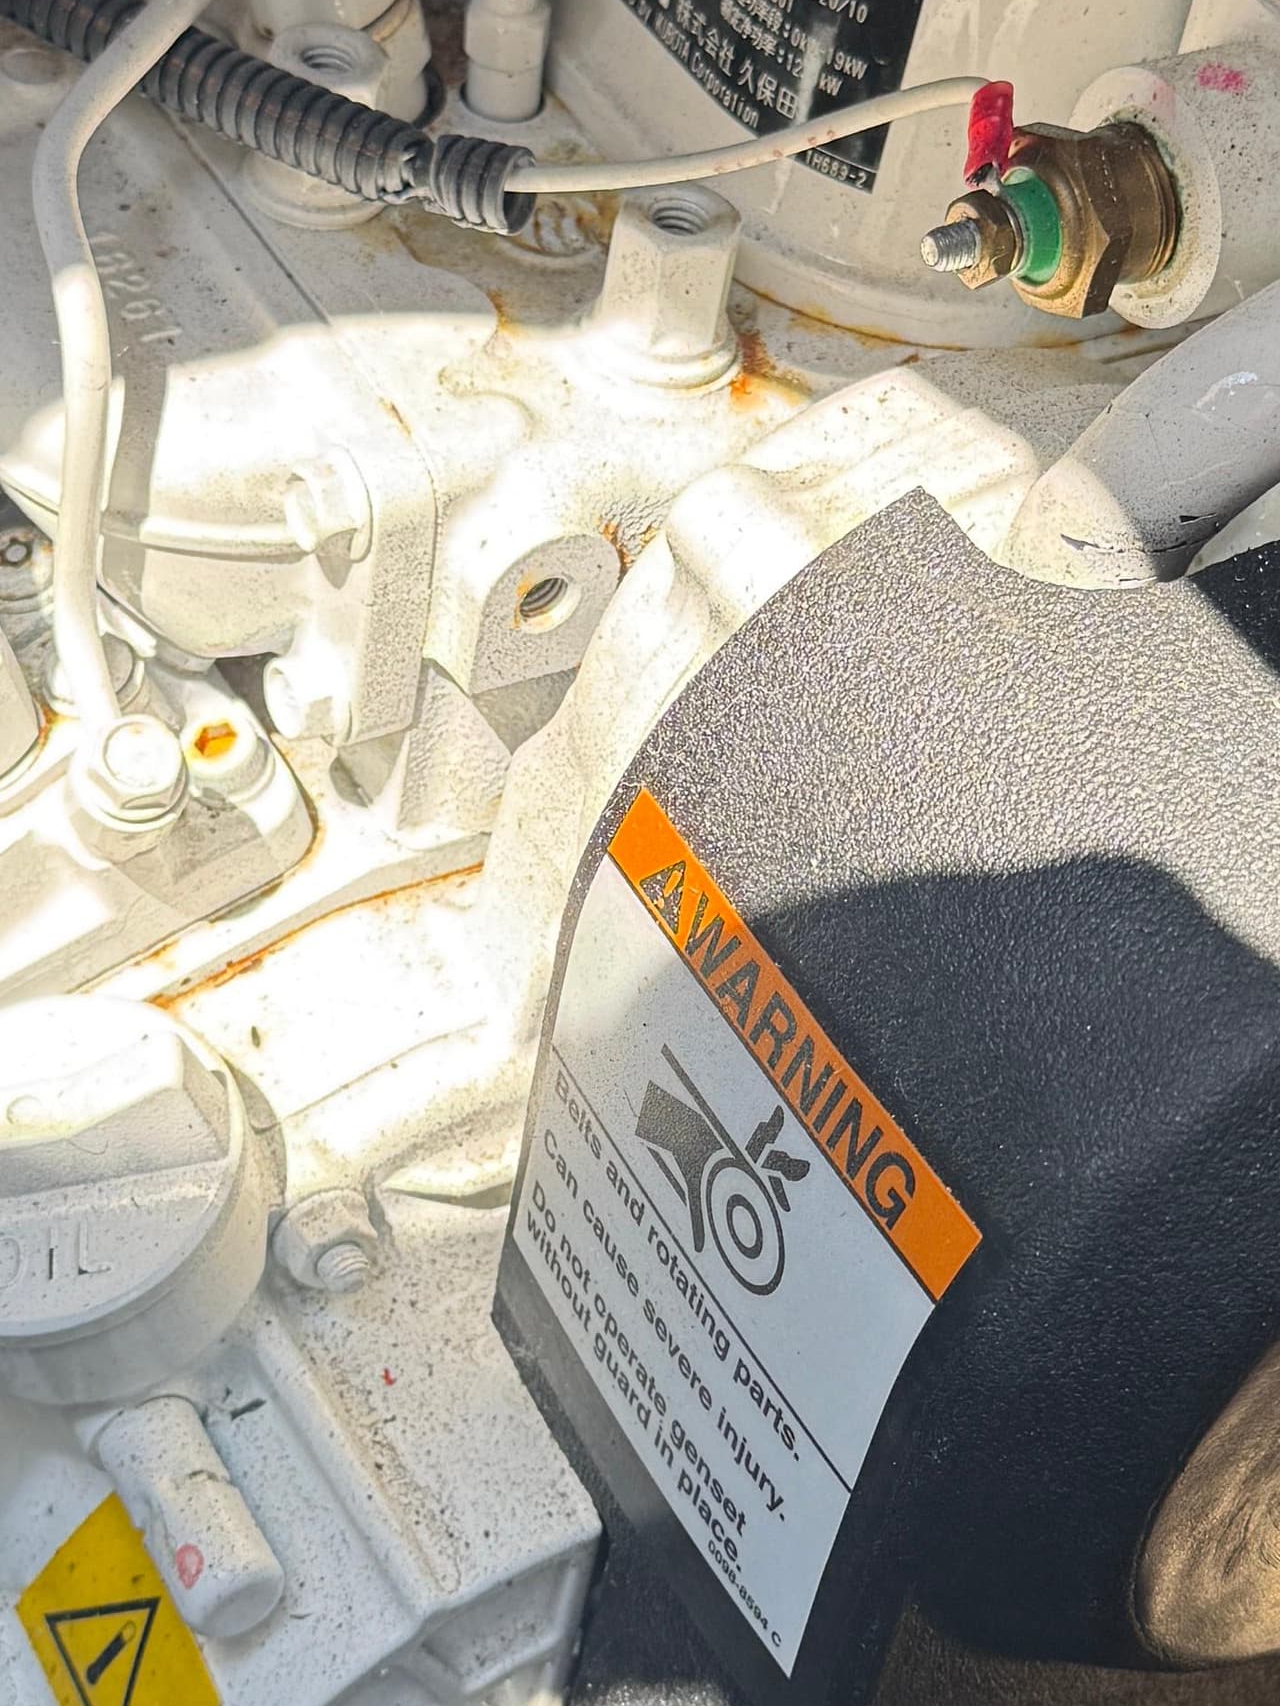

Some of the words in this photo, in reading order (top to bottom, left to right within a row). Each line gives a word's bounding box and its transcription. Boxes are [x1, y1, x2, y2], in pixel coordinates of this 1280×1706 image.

[691, 51, 759, 128] Corporation
[738, 57, 799, 119] 久保田
[682, 891, 916, 1229] WARNING
[526, 1210, 592, 1333] without
[592, 1332, 652, 1431] guard
[654, 1424, 674, 1469] in
[676, 1468, 742, 1574] place.
[531, 1179, 557, 1234] Do
[559, 1233, 591, 1292] not
[592, 1292, 667, 1418] operate
[669, 1419, 747, 1538] genset
[544, 1128, 579, 1200] Can
[582, 1198, 640, 1298] cause
[642, 1297, 713, 1411] severe
[716, 1406, 785, 1522] injury.
[554, 1070, 603, 1161] Belts
[605, 1159, 646, 1227] and
[646, 1224, 731, 1363] rotating
[732, 1357, 800, 1462] parts.
[708, 1539, 769, 1631] 0098-8594
[771, 1631, 782, 1647] C
